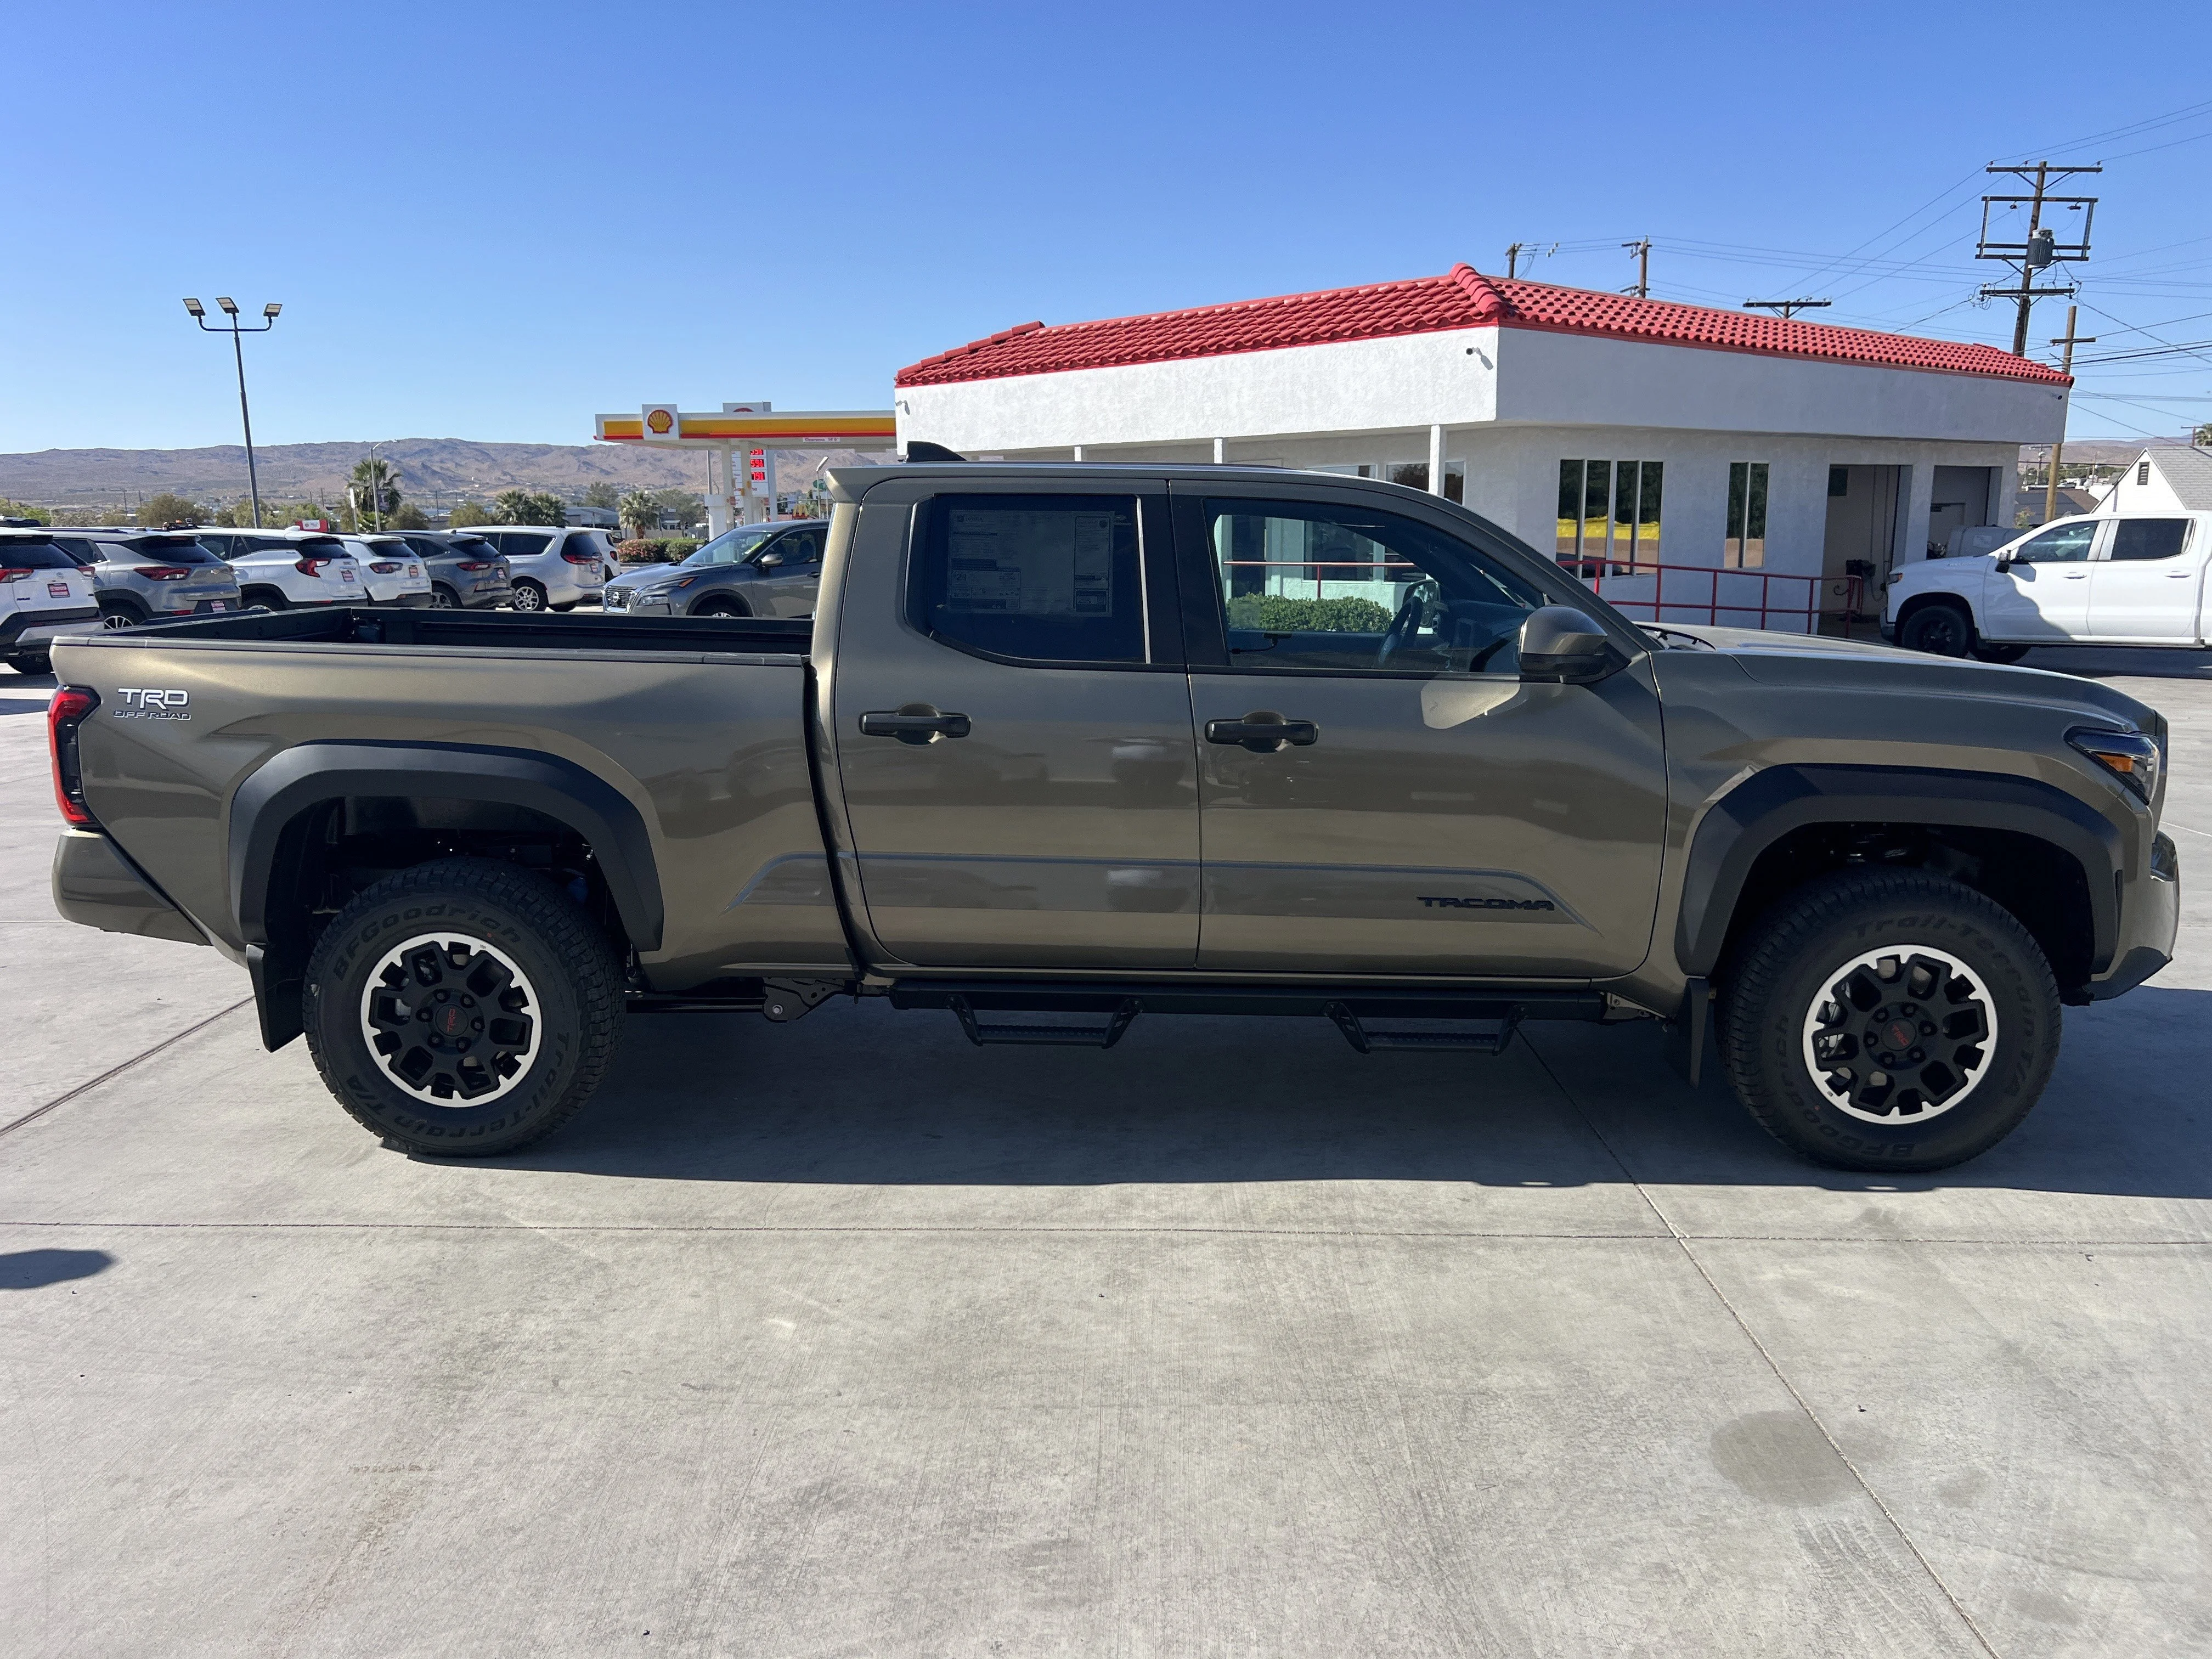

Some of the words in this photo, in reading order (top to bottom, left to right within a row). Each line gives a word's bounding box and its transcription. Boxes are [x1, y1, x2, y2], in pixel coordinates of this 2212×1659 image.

[118, 687, 191, 711] TRD
[113, 710, 146, 719] OFF
[148, 712, 191, 721] ROAD
[1417, 896, 1555, 911] TACOMA
[334, 904, 522, 980] BFGoodrich
[447, 1008, 456, 1032] TRD
